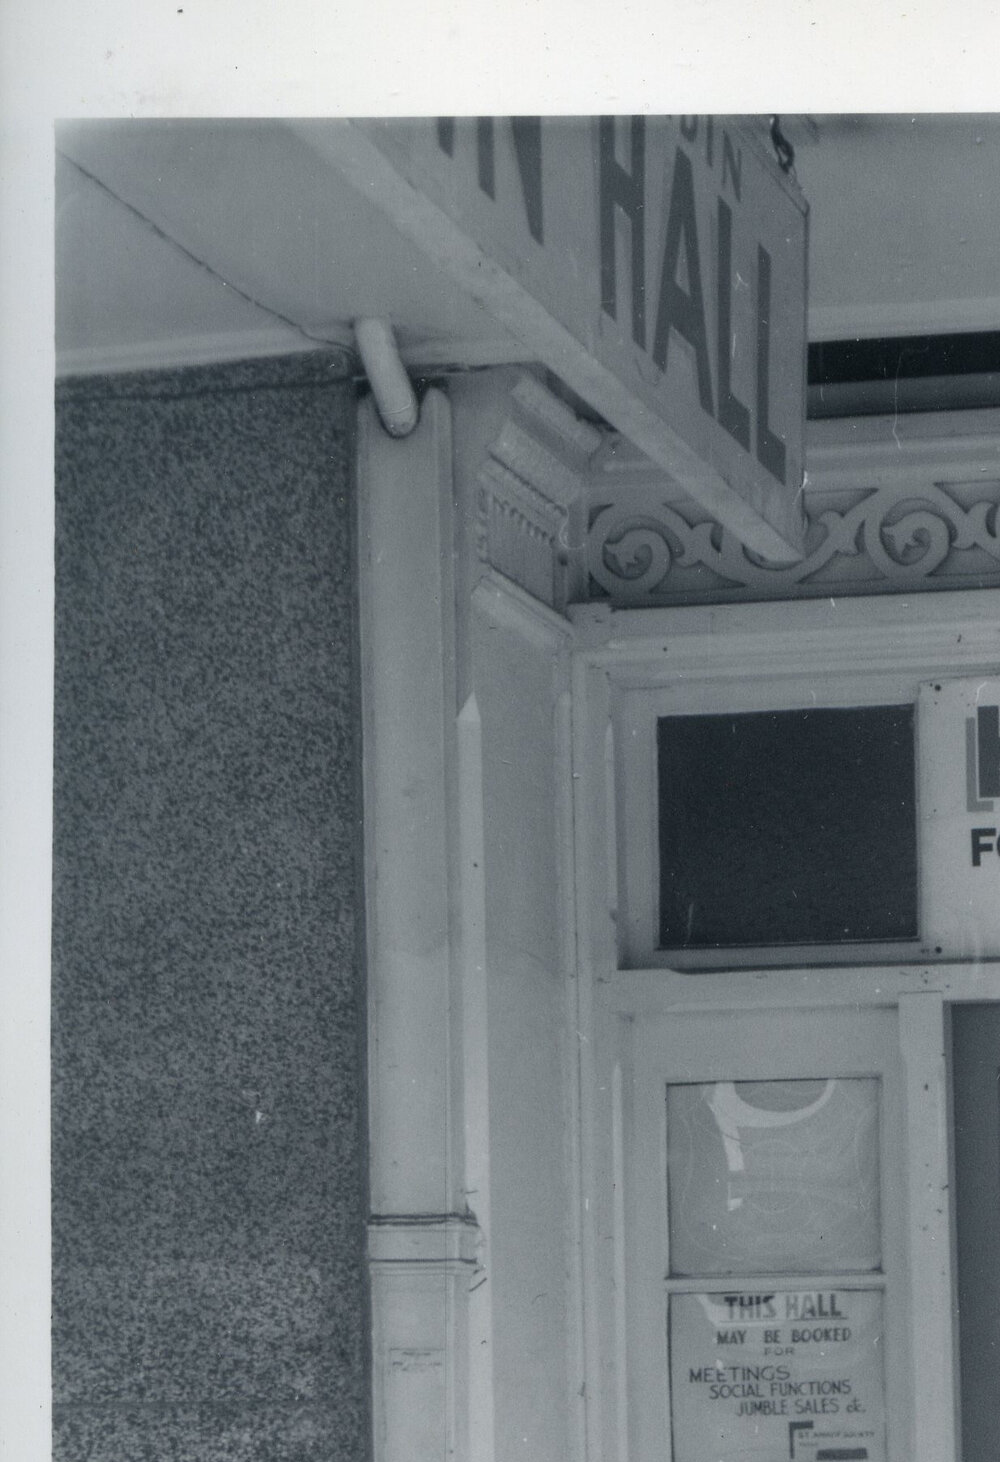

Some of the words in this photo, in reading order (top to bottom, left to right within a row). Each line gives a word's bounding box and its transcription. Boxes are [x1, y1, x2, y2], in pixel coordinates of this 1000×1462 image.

[600, 114, 786, 486] HALL
[724, 1295, 777, 1319] THIS
[786, 1293, 842, 1318] HALL
[716, 1330, 747, 1345] MAY
[764, 1329, 781, 1344] BE
[791, 1327, 852, 1344] BOOKED
[764, 1348, 795, 1356] FOR
[689, 1365, 791, 1384] MEETINGS
[709, 1384, 764, 1400] SOCIAL
[770, 1379, 852, 1397] FUNCTIONS
[736, 1400, 788, 1417] JUMBLE
[795, 1397, 840, 1415] SALES
